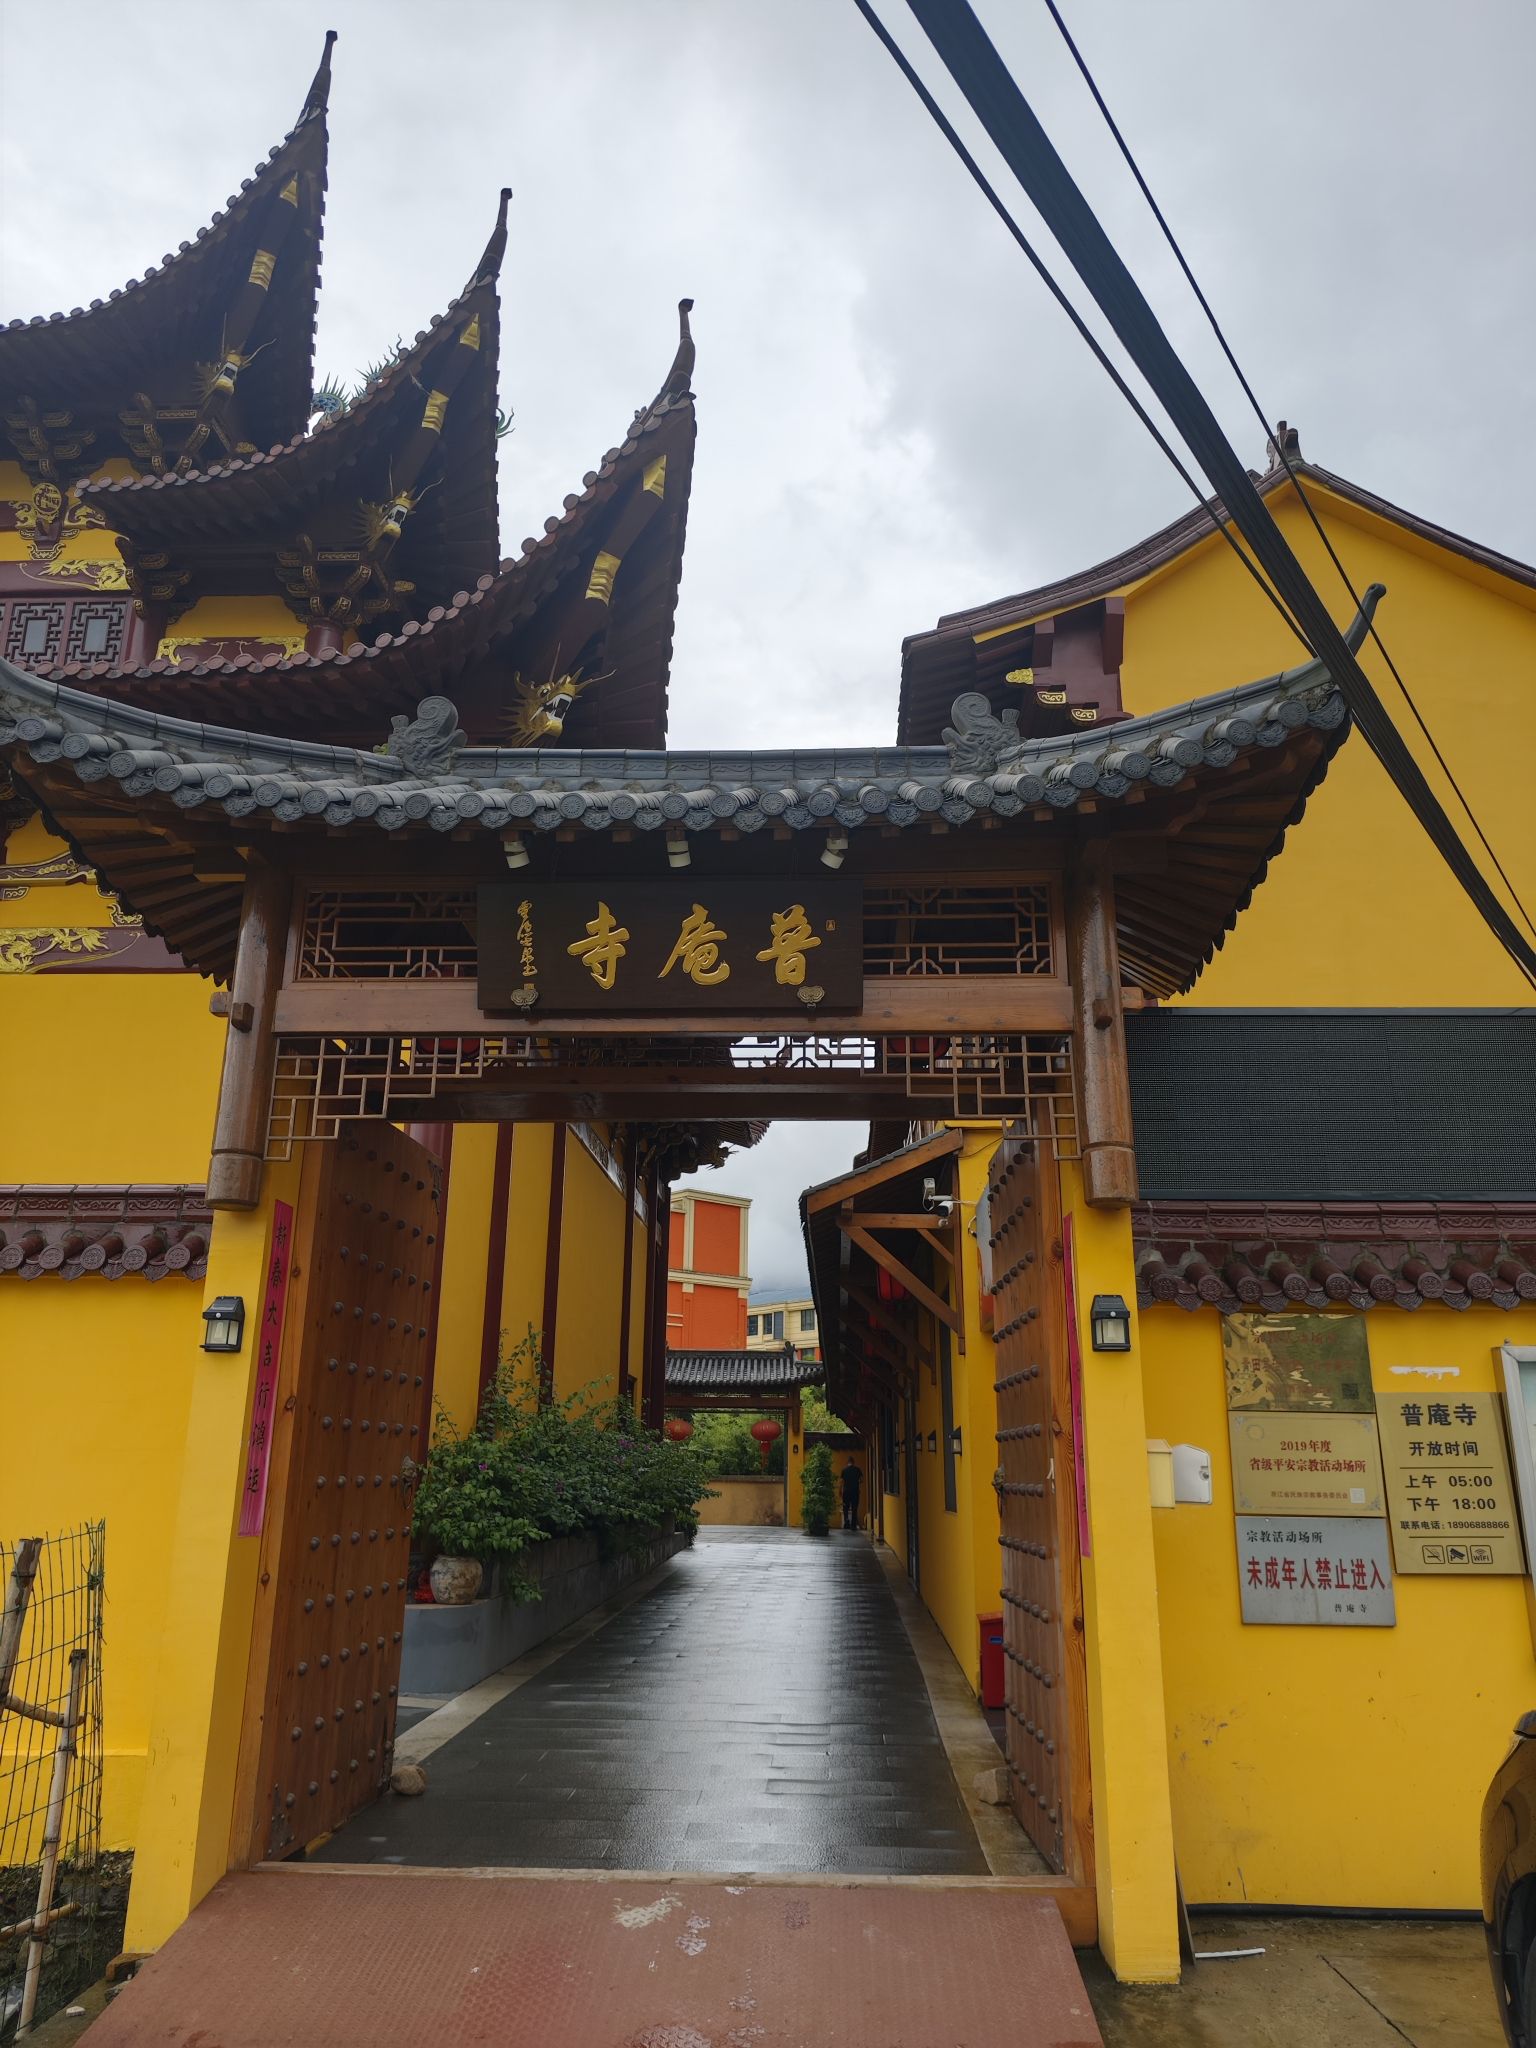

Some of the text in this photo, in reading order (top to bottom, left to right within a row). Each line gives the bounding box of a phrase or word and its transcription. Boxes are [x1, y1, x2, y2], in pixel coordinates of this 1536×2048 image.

[1401, 1403, 1477, 1427] 普庵寺
[1280, 1440, 1332, 1454] 2019年度
[1409, 1441, 1479, 1457] 开放时间
[1249, 1457, 1366, 1473] 省级平安宗教活动场所
[1405, 1474, 1493, 1489] 上午 05:00
[1407, 1497, 1496, 1512] 下午 18:00
[1246, 1530, 1323, 1544] 宗教活动场所
[1247, 1556, 1386, 1591] 未成年人禁止进入
[1334, 1603, 1368, 1614] 普庵寺
